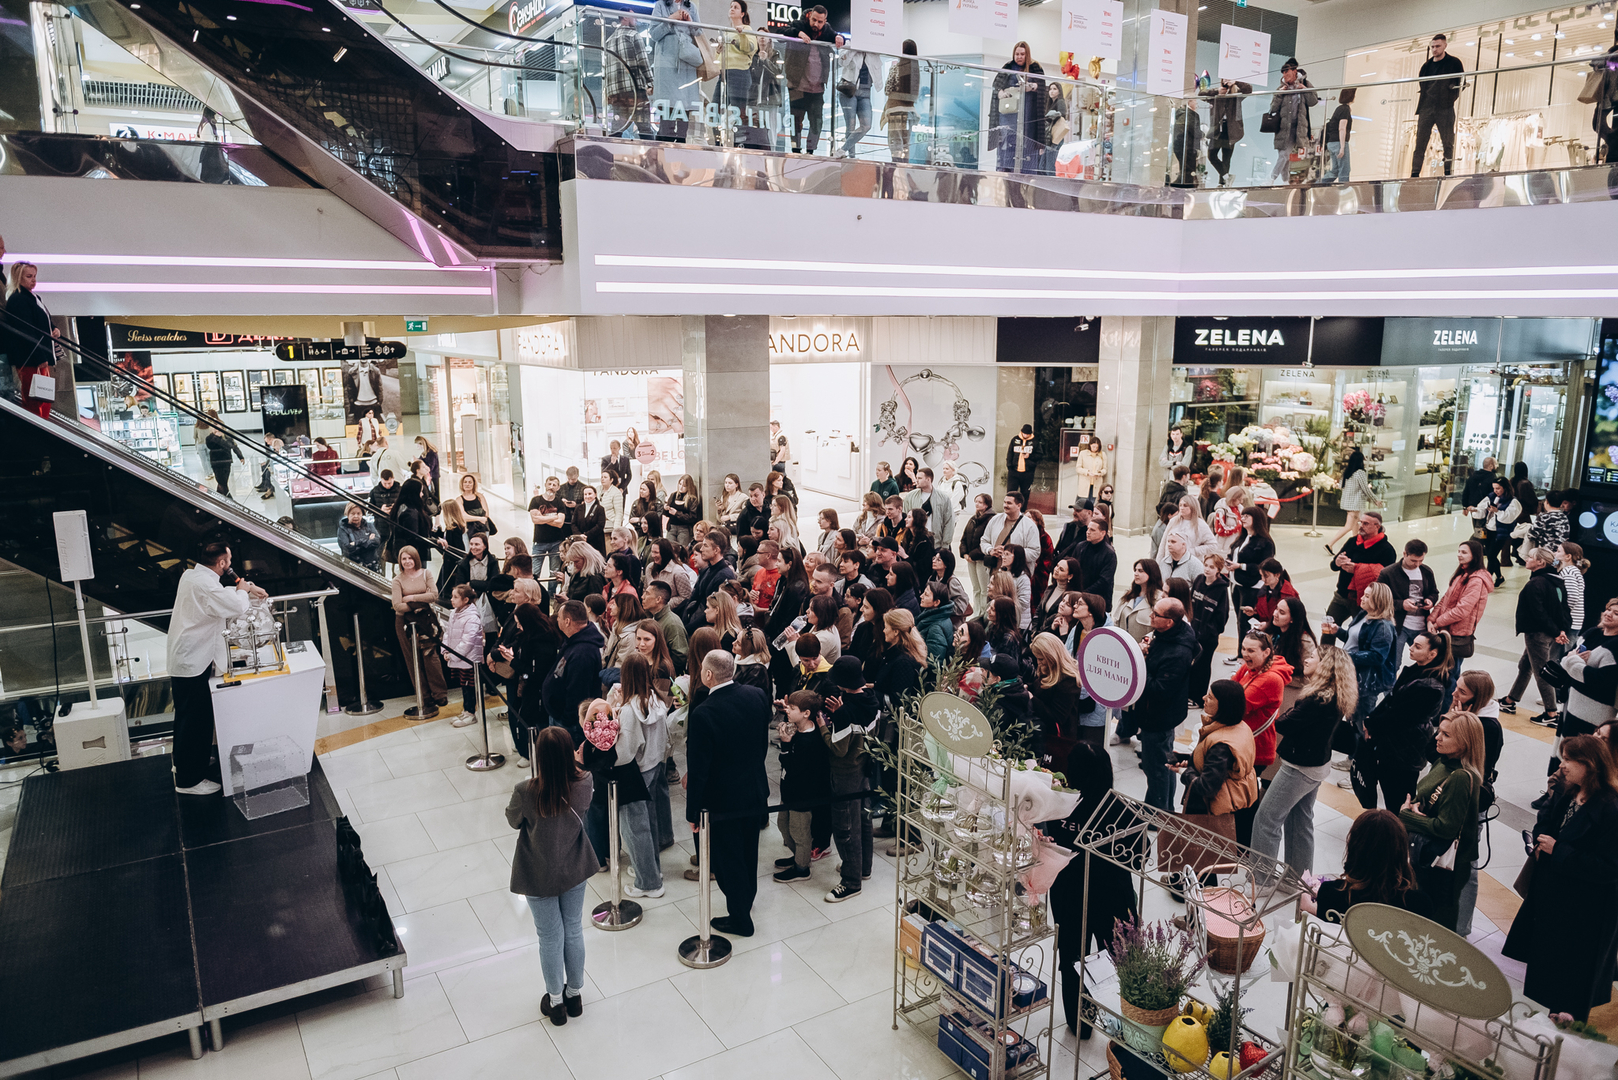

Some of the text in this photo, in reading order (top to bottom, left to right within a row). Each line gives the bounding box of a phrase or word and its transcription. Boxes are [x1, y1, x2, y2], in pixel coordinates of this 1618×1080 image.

[127, 329, 187, 342] Swiss watches
[1194, 329, 1285, 346] ZELENA
[1432, 330, 1478, 345] ZELENA
[769, 333, 860, 354] ANDORA
[287, 345, 295, 359] 1
[1280, 369, 1316, 378] ZELENA
[1096, 654, 1120, 670] КВІТИ
[1086, 664, 1129, 686] ДЛЯ МАМИ
